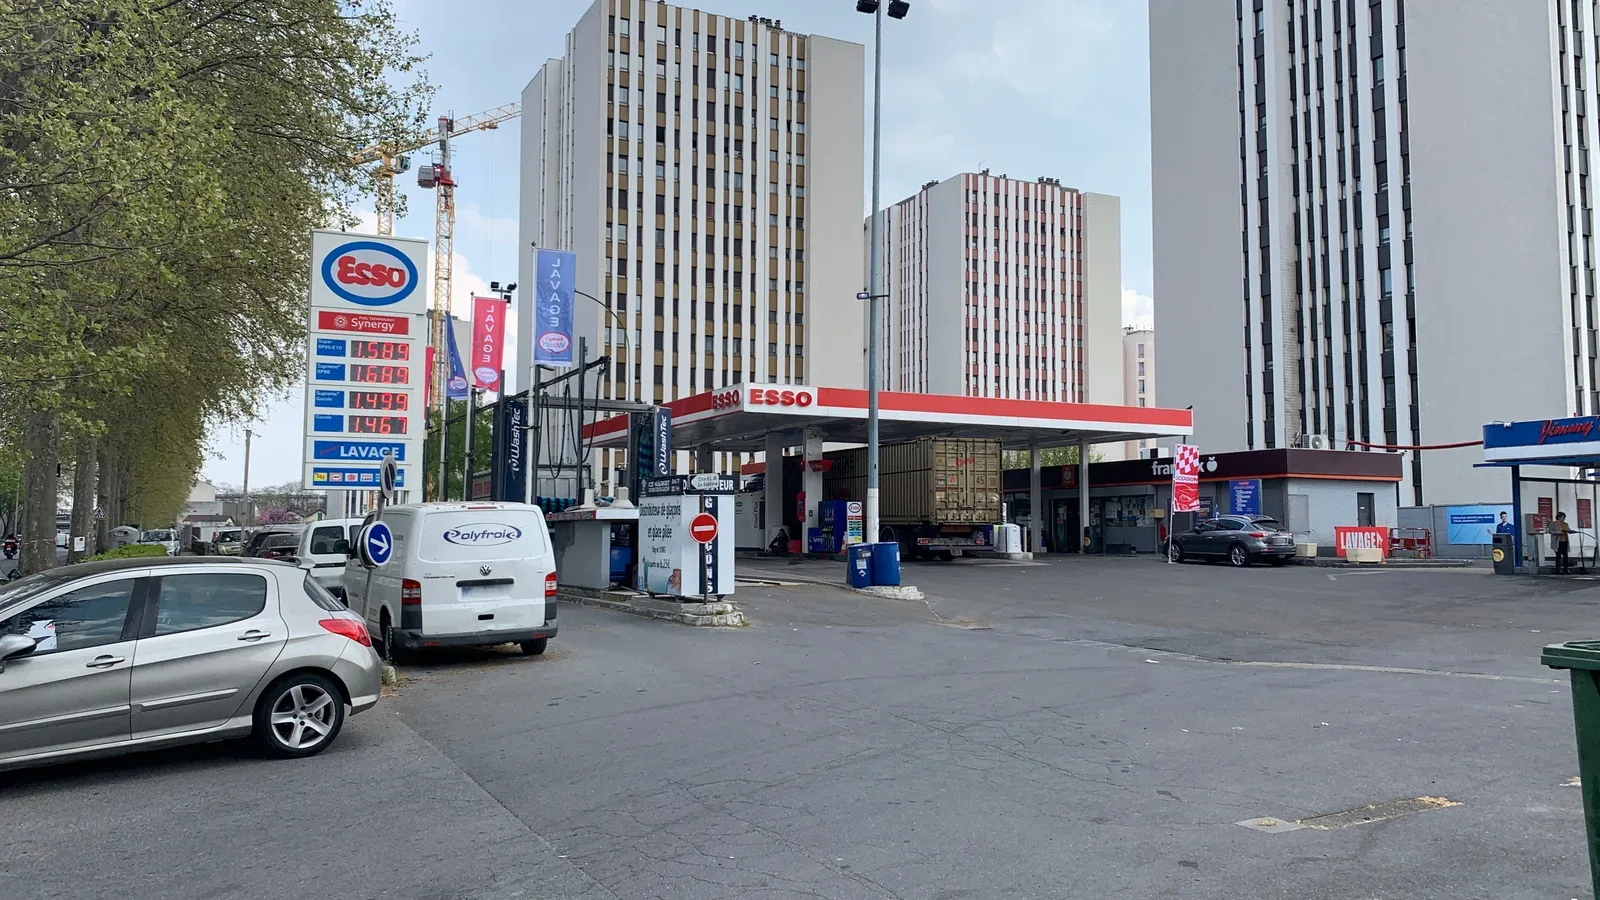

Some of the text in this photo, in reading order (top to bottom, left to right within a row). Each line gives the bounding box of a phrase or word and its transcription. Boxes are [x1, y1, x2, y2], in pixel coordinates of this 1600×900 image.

[337, 255, 406, 289] Esso
[351, 318, 394, 332] Synergy
[357, 341, 409, 361] 1.589
[357, 365, 408, 385] 1.689
[356, 392, 407, 411] 1.499
[712, 389, 740, 410] ESSO
[749, 388, 813, 407] ESSO
[355, 416, 408, 434] 1.467
[340, 446, 400, 458] LAVAGE
[975, 475, 985, 486] 45
[1340, 531, 1376, 549] LAVAGE
